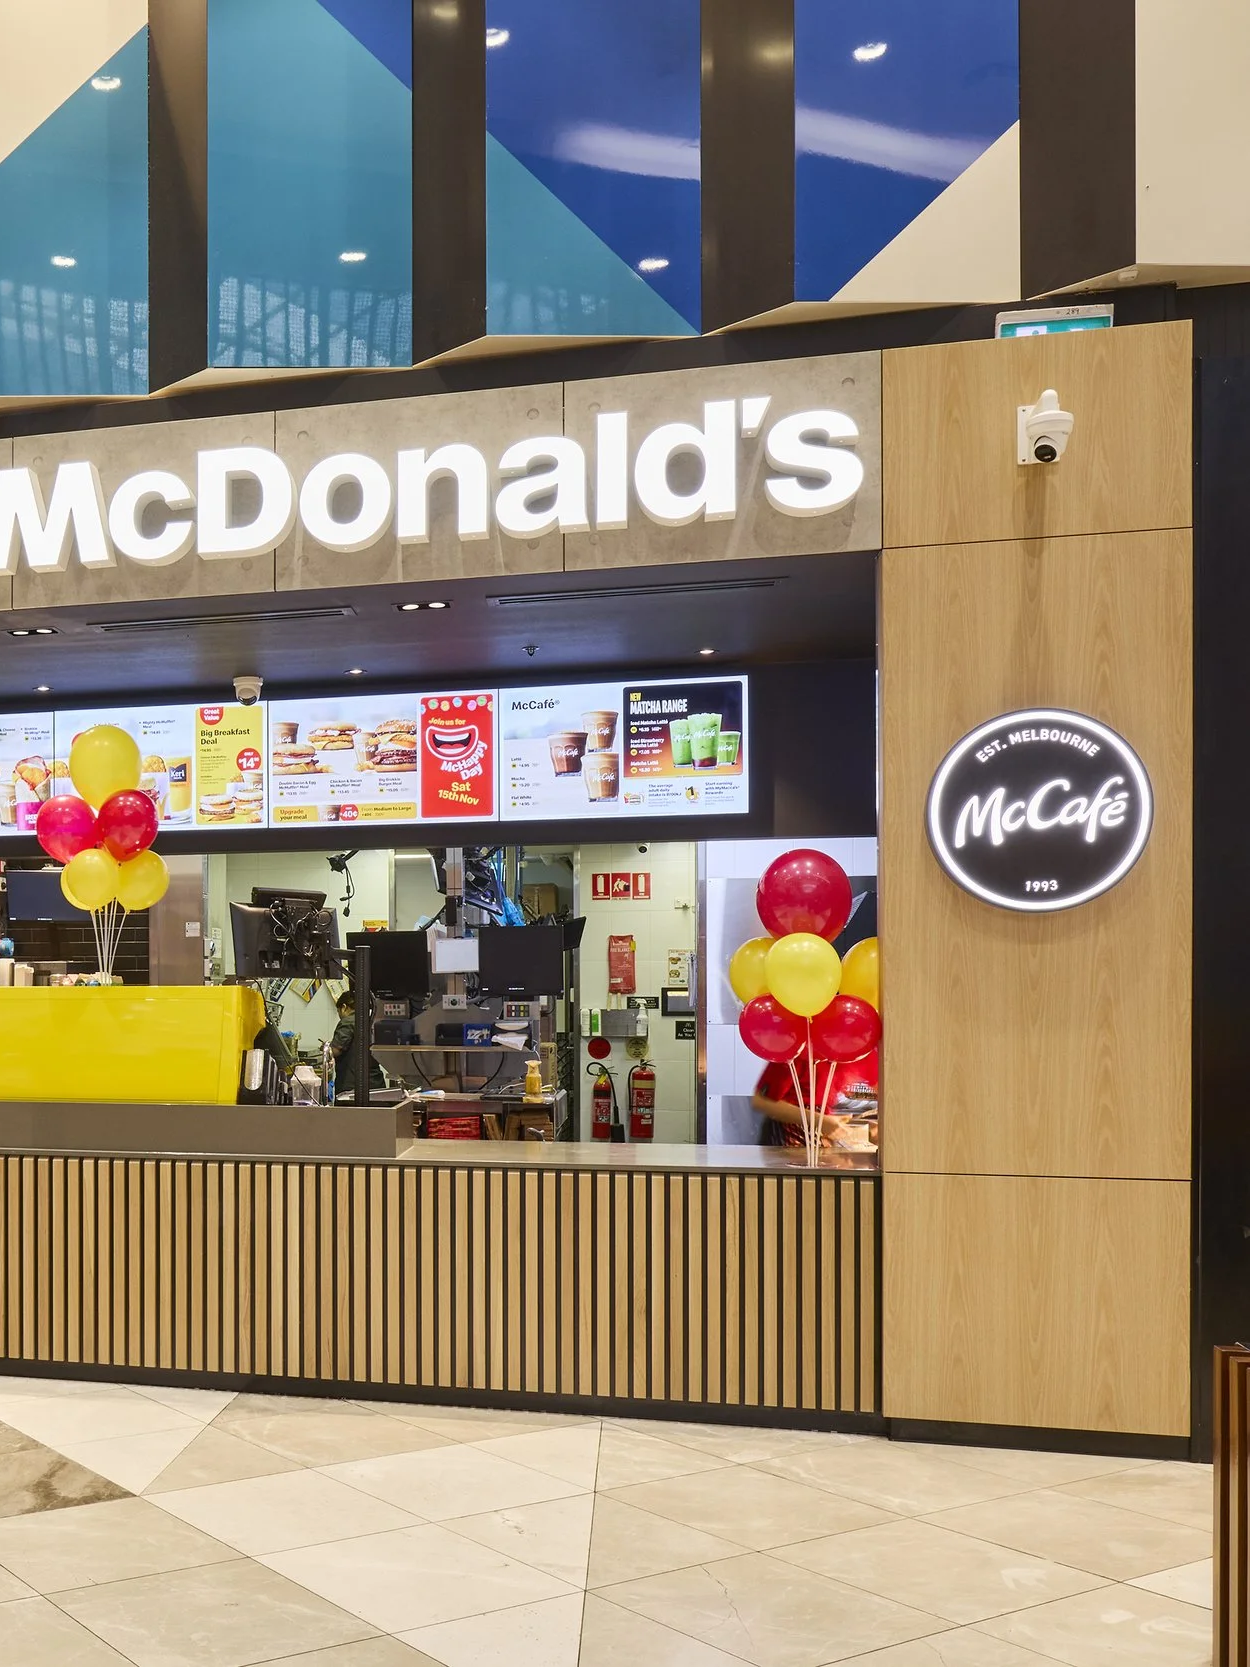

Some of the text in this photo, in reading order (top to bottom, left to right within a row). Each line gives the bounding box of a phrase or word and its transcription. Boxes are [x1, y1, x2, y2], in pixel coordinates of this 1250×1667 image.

[630, 692, 642, 701] NEW
[630, 699, 688, 715] MATCHA RANGE
[429, 717, 445, 725] Join
[200, 728, 250, 738] Big Breakfast
[975, 728, 1101, 763] EST. MELBOURNE
[440, 740, 488, 772] McHappy
[459, 763, 483, 780] Day
[451, 781, 471, 792] Sat
[438, 789, 479, 805] 15th Nov
[954, 776, 1129, 848] McCafé
[1024, 879, 1059, 892] 1993
